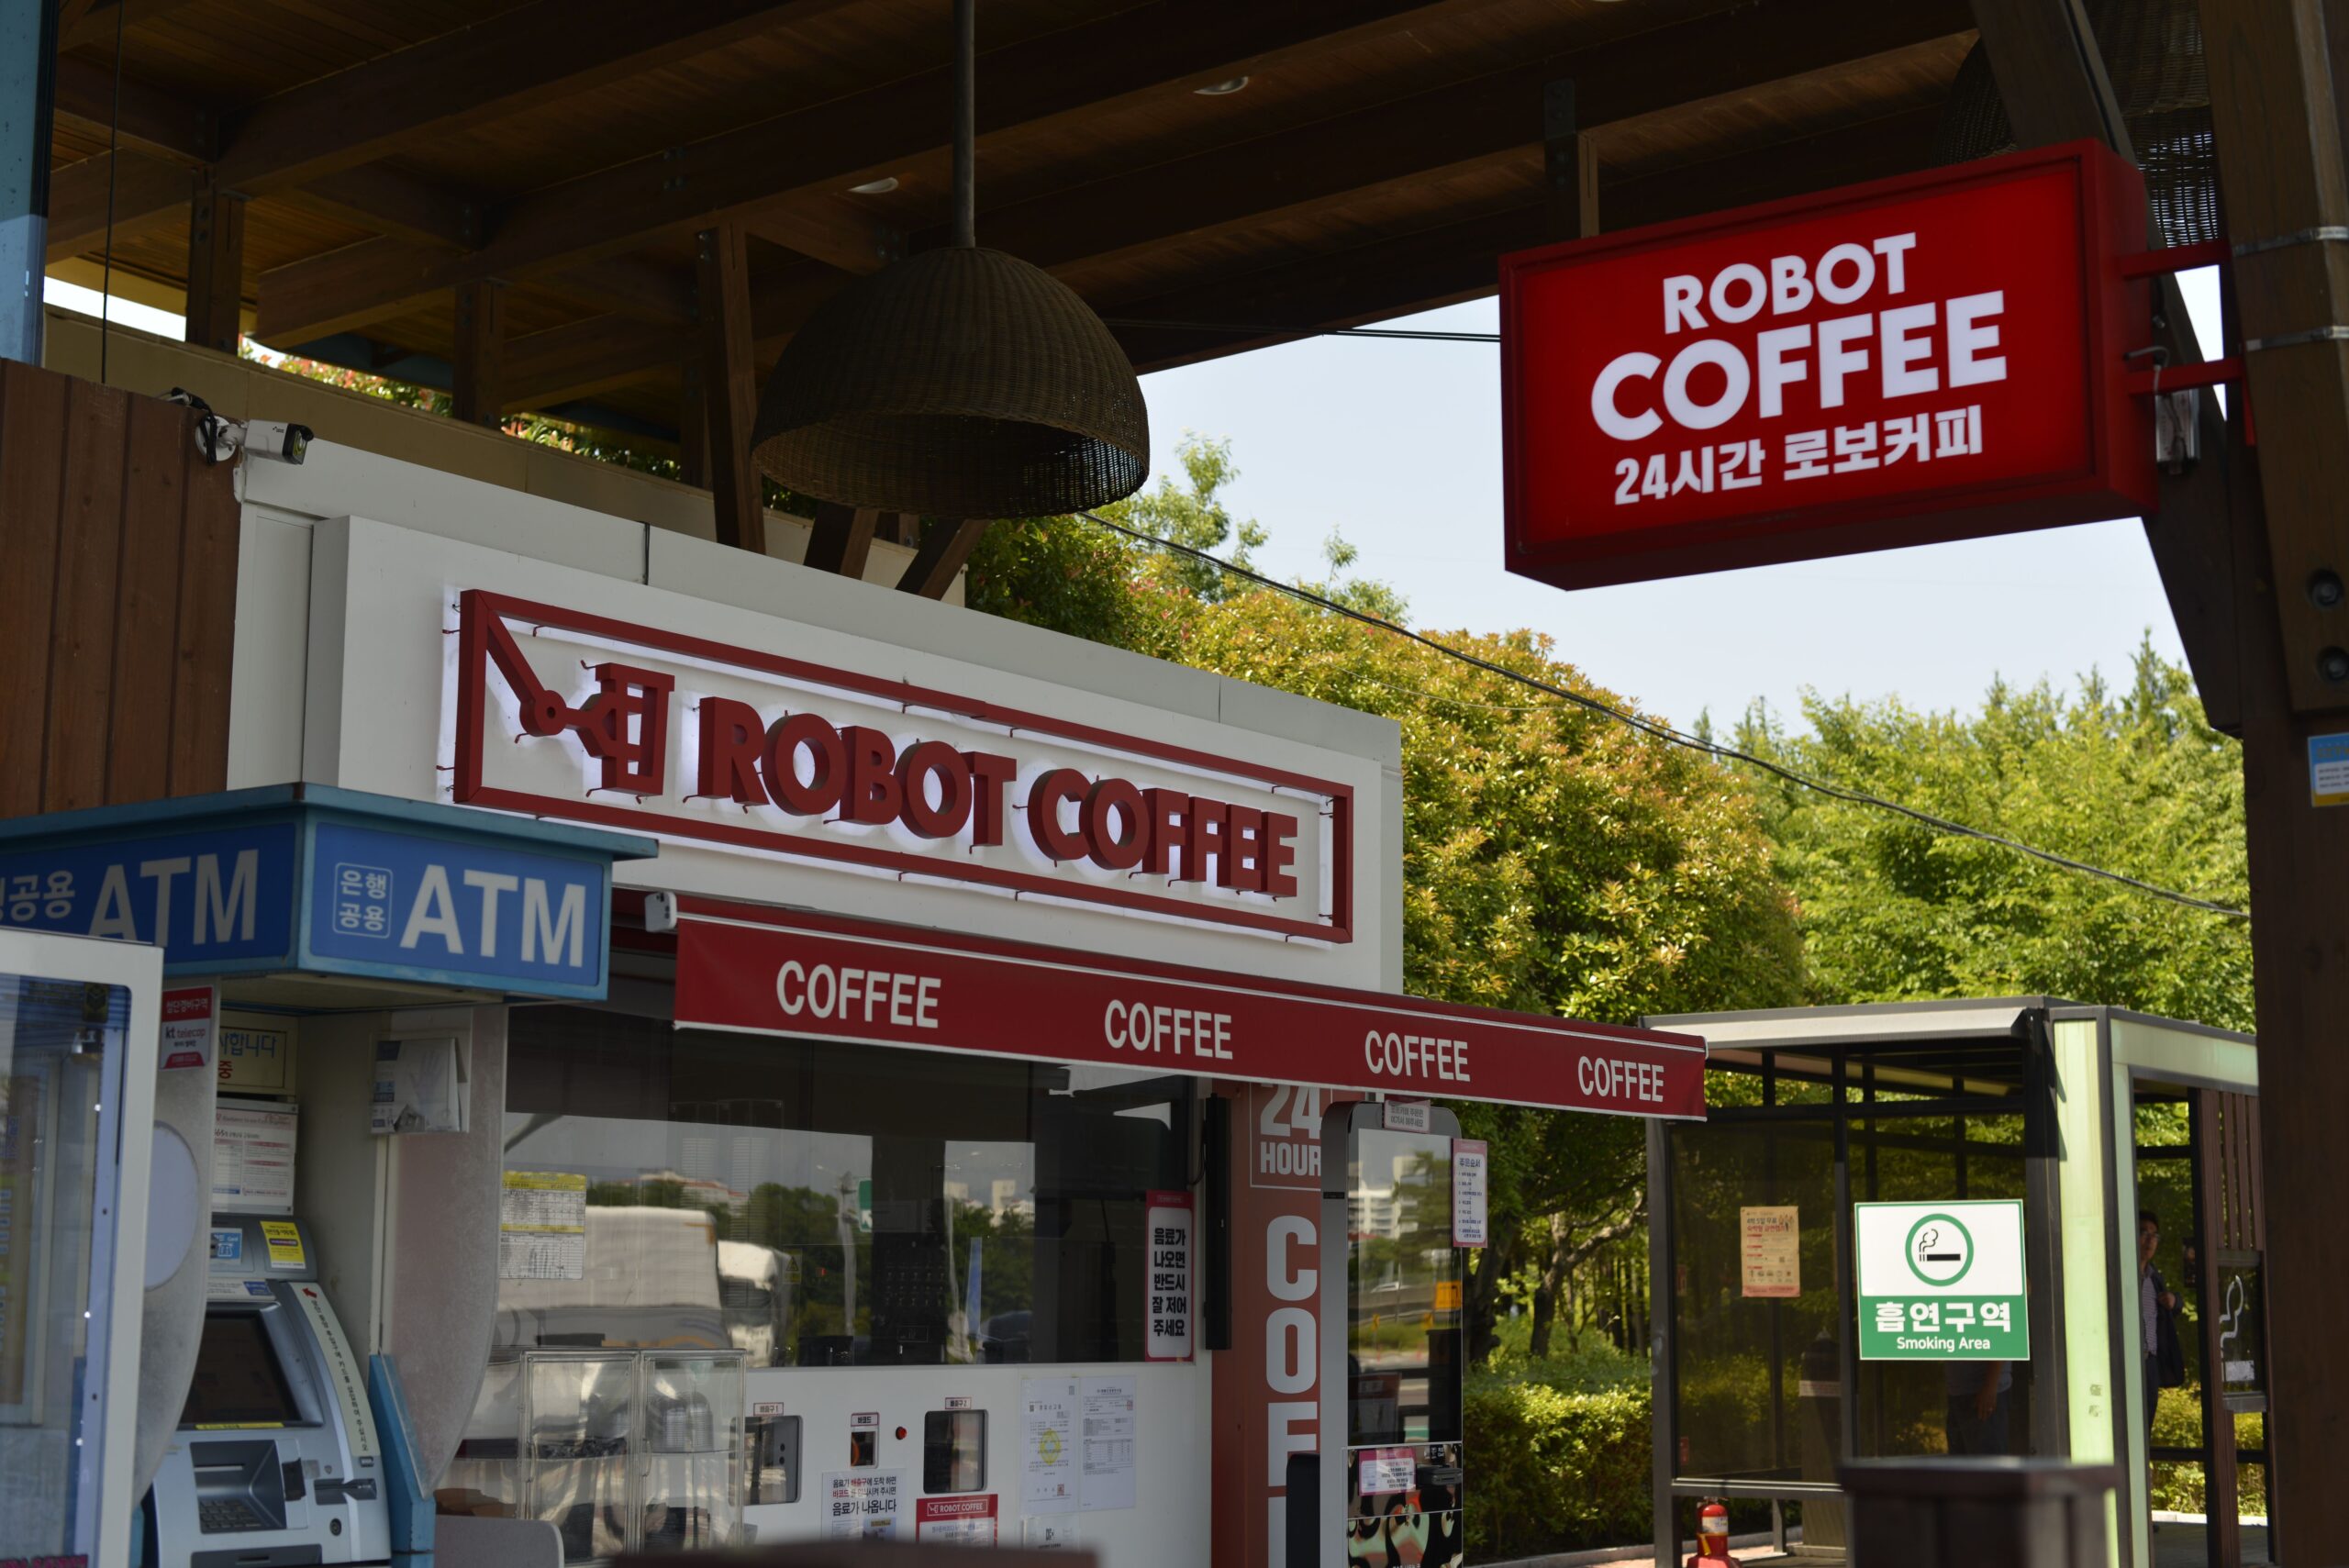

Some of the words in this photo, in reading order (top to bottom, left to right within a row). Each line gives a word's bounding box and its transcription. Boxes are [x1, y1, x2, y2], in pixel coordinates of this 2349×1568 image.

[1663, 232, 1917, 334] ROBOT
[1591, 290, 2007, 441] COFFEE
[1614, 439, 1765, 506] 24시간
[1784, 405, 1983, 481] 로보커피
[697, 696, 1018, 846] ROBOT
[1028, 768, 1297, 897] COFFEE
[88, 849, 259, 947] ATM
[340, 870, 387, 899] 은행
[339, 903, 385, 931] 공용
[400, 864, 585, 967] ATM
[776, 961, 941, 1029] COFFEE
[165, 1027, 175, 1040] kt
[177, 1028, 206, 1039] telecop
[1104, 999, 1233, 1060] COFFEE
[1364, 1029, 1470, 1082] COFFEE
[1577, 1056, 1664, 1102] COFFEE
[1260, 1084, 1322, 1139] 24
[1154, 1228, 1186, 1246] 음료가
[1154, 1251, 1186, 1268] 나오면
[1154, 1273, 1185, 1291] 반드시
[1152, 1296, 1163, 1314] 잘
[1166, 1296, 1186, 1314] 저어
[1876, 1302, 2011, 1333] 흡연구역
[1153, 1319, 1185, 1337] 주세요
[1897, 1336, 1955, 1352] Smoking
[1959, 1337, 1990, 1350] Area
[833, 1479, 849, 1488] 음료가
[874, 1477, 885, 1485] 도착
[832, 1501, 859, 1517] 음료가
[863, 1498, 896, 1514] 나옵니다
[940, 1504, 960, 1513] ROBOT
[962, 1503, 984, 1511] COFFEE
